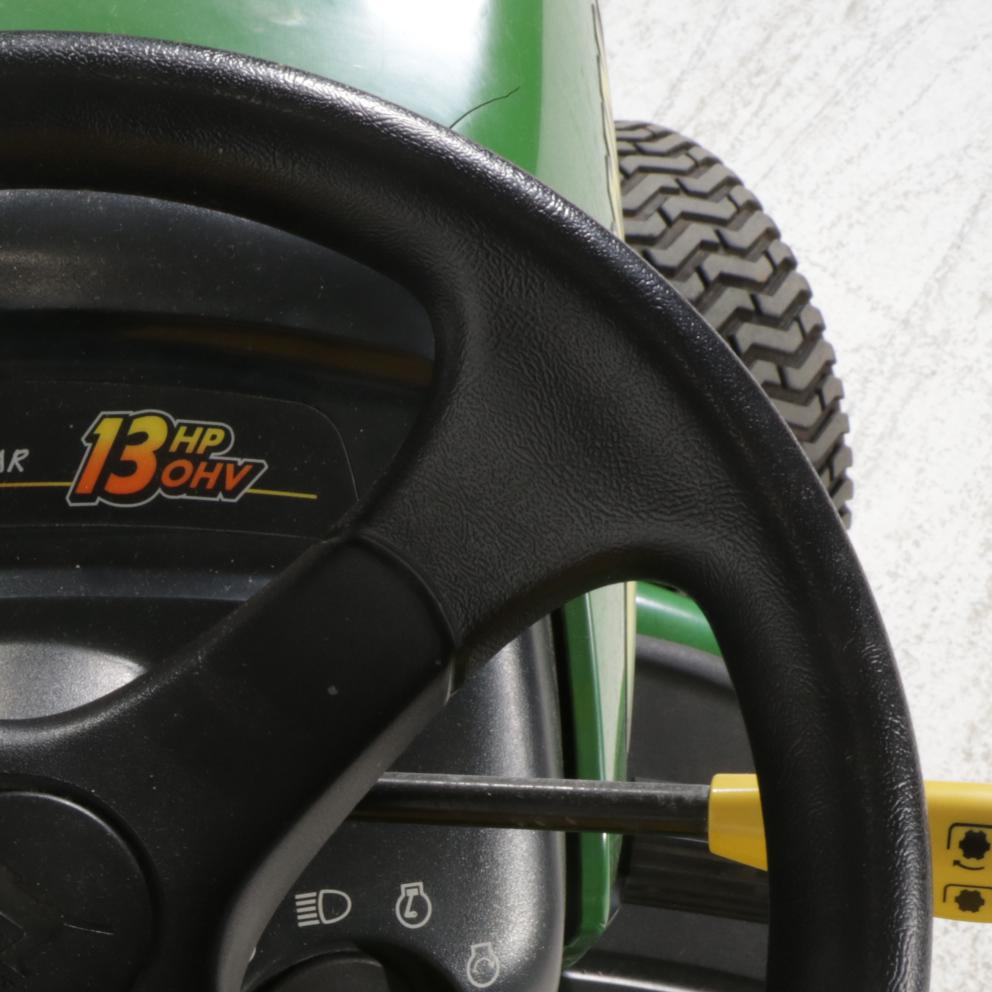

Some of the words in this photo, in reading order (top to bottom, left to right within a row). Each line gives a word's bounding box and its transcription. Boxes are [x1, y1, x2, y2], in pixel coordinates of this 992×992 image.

[75, 414, 167, 496] 13
[168, 425, 225, 452] HP
[160, 462, 252, 491] OHV
